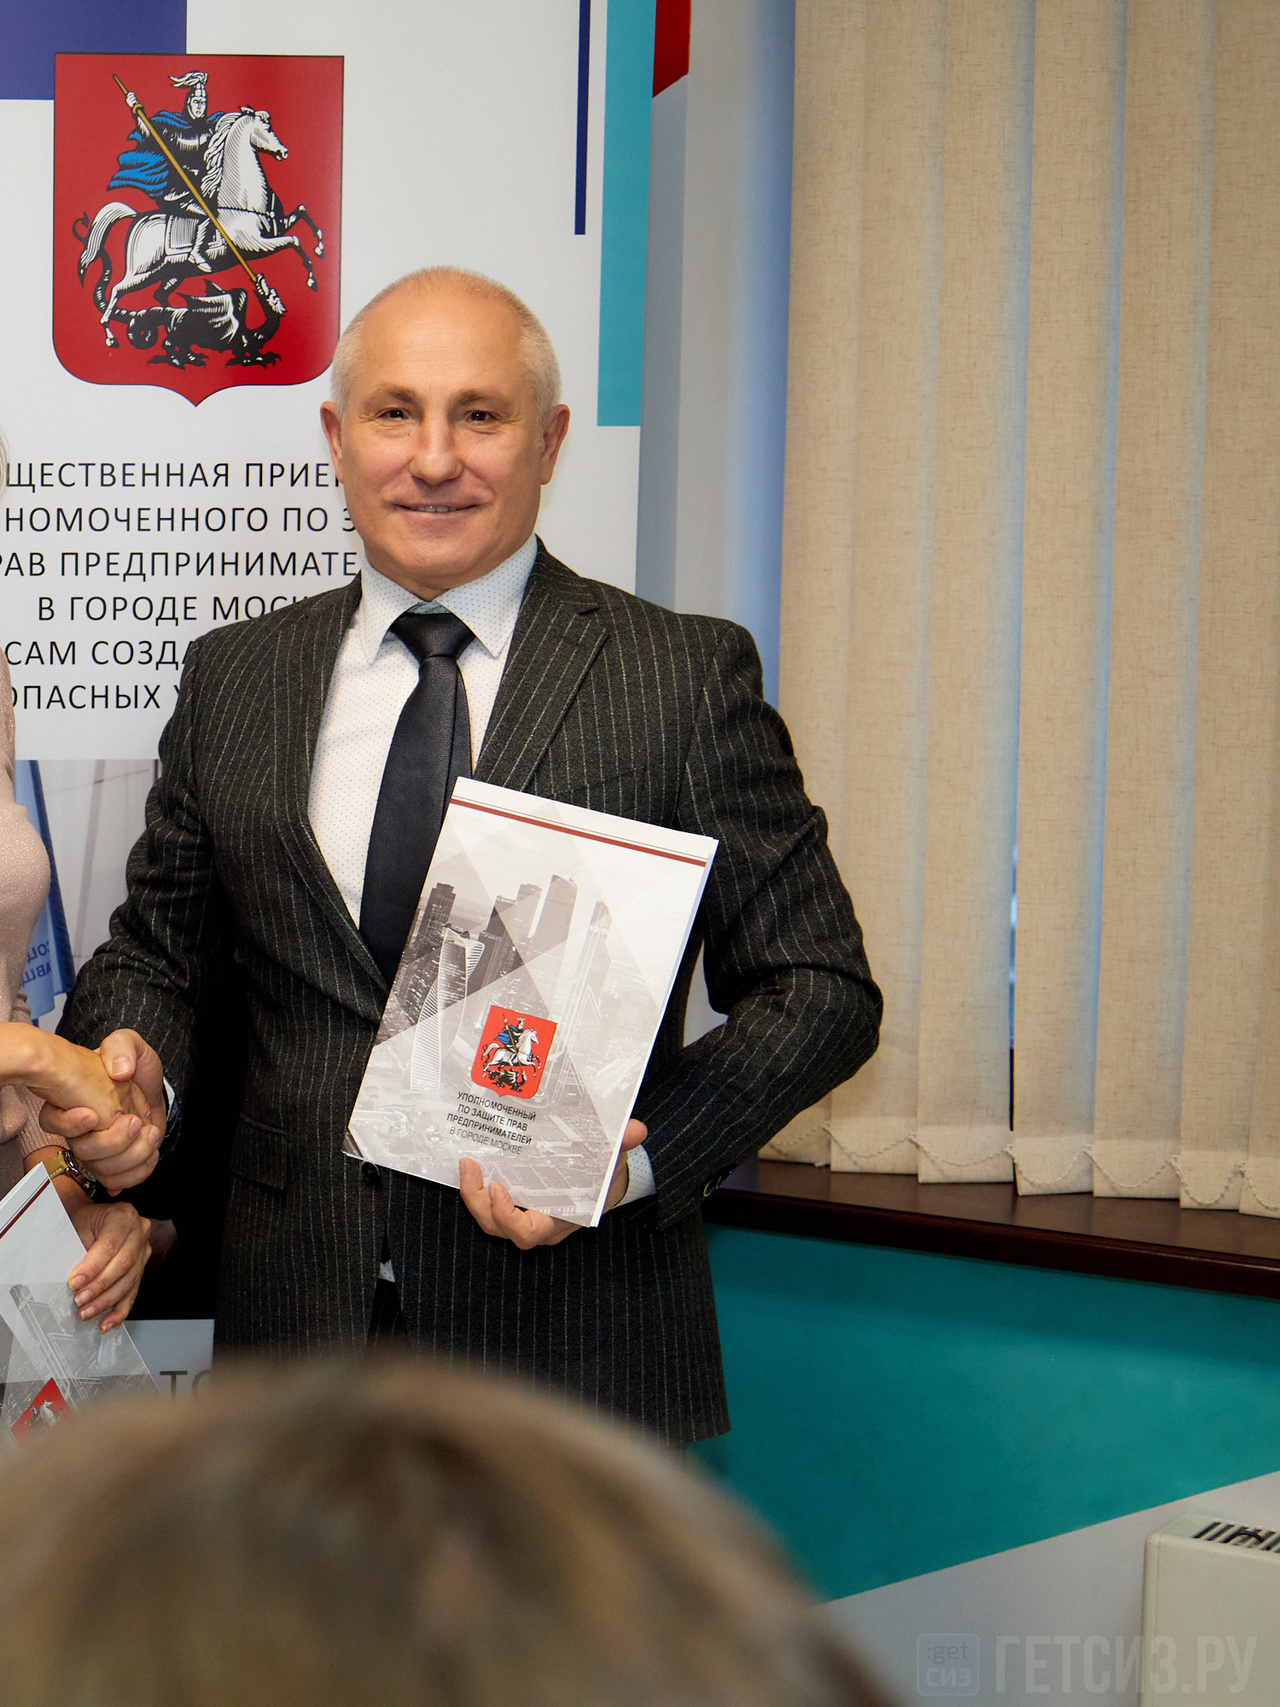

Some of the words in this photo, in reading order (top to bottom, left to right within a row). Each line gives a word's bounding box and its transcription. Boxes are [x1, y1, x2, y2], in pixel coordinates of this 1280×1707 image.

[245, 462, 341, 488] ПРИЕ
[283, 507, 328, 533] ПО
[61, 551, 357, 582] ПРЕДПРИНИМАТЕ
[38, 597, 55, 621] В
[70, 596, 197, 627] ГОРОДЕ
[213, 595, 308, 620] МОС
[5, 640, 76, 666] САМ
[457, 1092, 536, 1121] УПОЛНОМОЧЕННЫЙ
[458, 1104, 470, 1114] ПО
[471, 1109, 505, 1125] ЗАЩИТЕ
[506, 1118, 528, 1131] ПРАВ
[447, 1113, 532, 1145] ПРЕДПРИНИМАТЕЛЕЙ
[449, 1127, 455, 1135] В
[456, 1129, 489, 1145] ГОРОДЕ
[489, 1139, 522, 1155] МОСКВЕ
